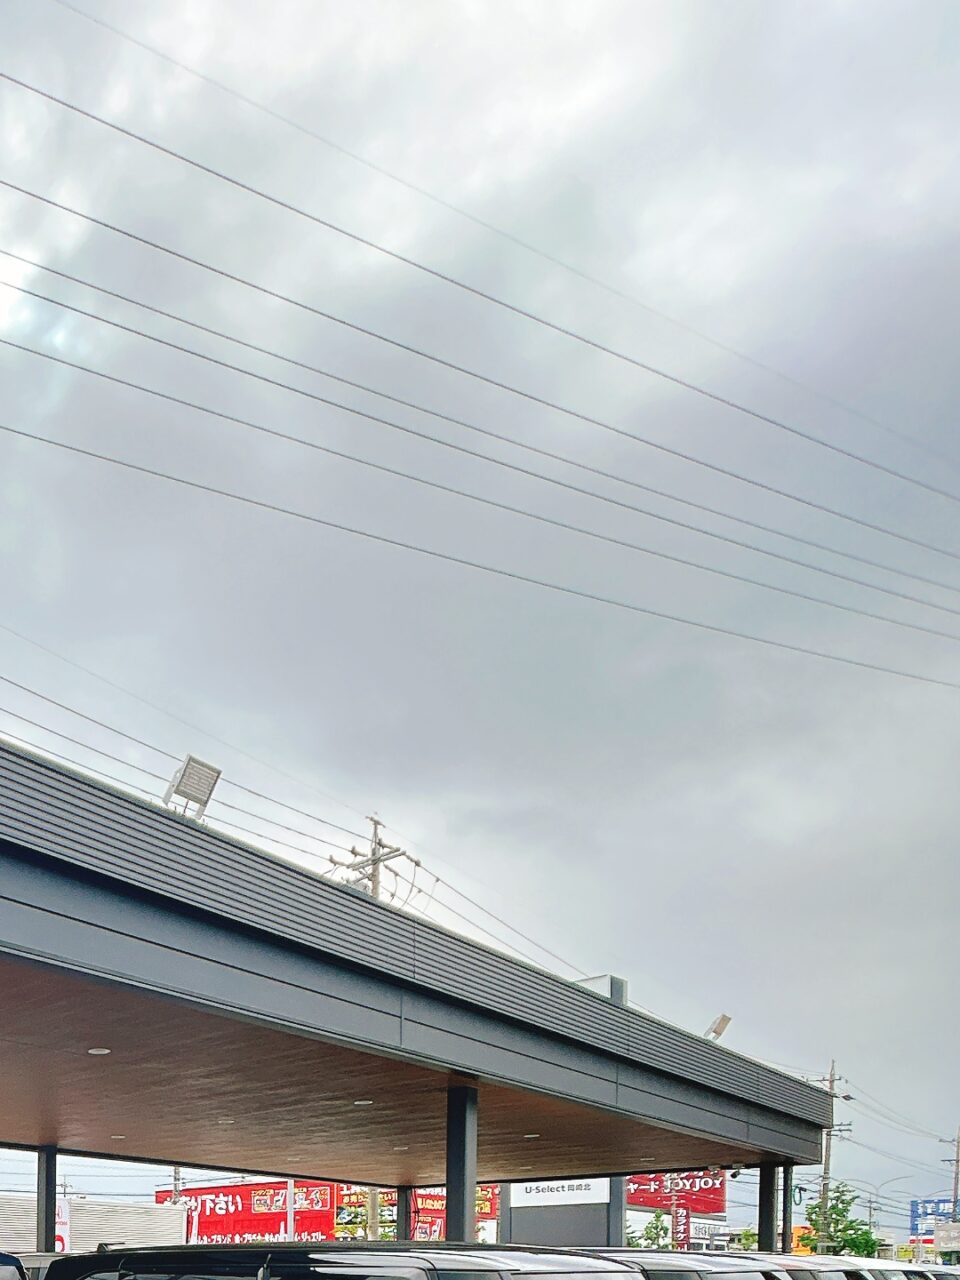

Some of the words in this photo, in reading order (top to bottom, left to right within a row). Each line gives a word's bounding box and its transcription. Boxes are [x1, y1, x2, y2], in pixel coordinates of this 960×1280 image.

[525, 1185, 566, 1194] U-Select
[664, 1177, 723, 1193] JOYJOY
[677, 1208, 687, 1242] カラオケ
